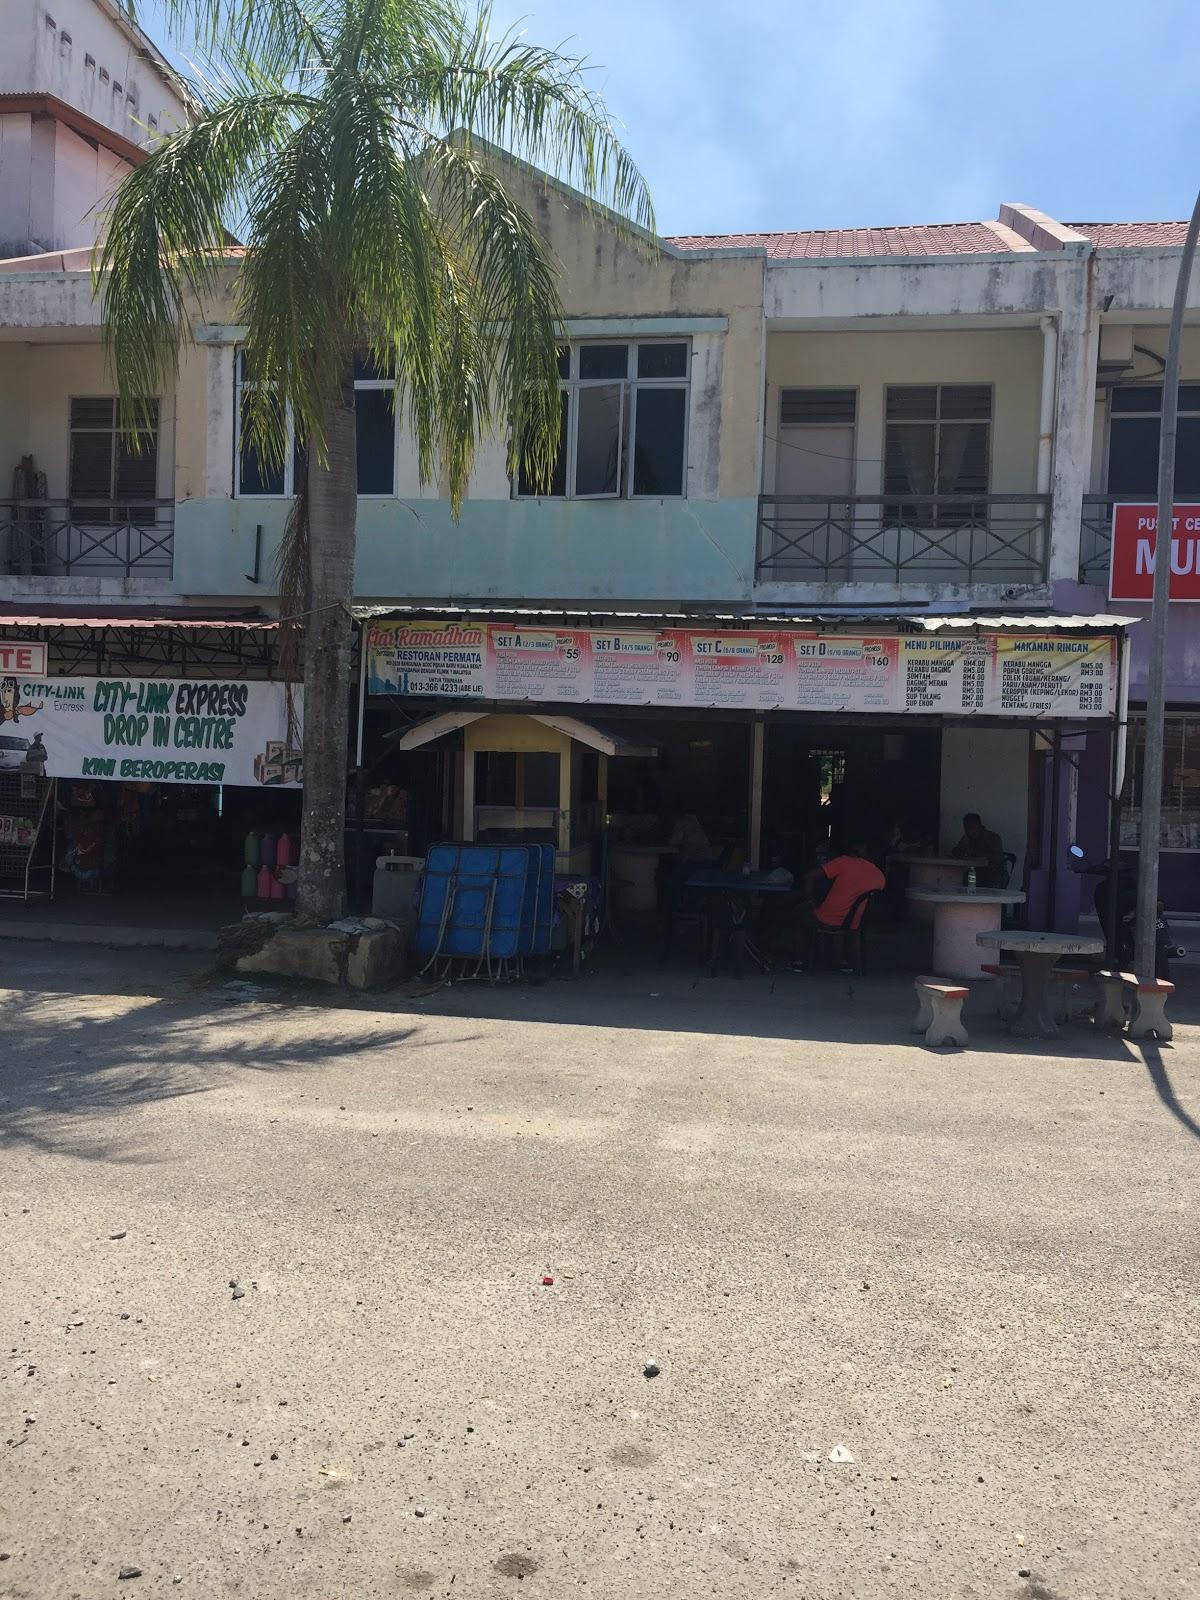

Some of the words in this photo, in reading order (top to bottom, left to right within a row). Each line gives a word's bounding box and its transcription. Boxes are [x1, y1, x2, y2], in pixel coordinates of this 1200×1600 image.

[1138, 517, 1180, 531] PUT
[1135, 538, 1200, 576] MU
[398, 625, 482, 647] Ramadhan
[498, 636, 512, 647] SET
[515, 634, 522, 647] A
[596, 640, 611, 651] SET
[614, 637, 621, 651] B
[697, 643, 713, 653] SET
[715, 640, 722, 653] C
[800, 645, 816, 655] SET
[819, 643, 826, 655] D
[905, 640, 927, 650] MENU
[929, 640, 961, 651] PILIHAN
[1014, 641, 1054, 652] MAKANAN
[1057, 642, 1089, 653] RINGAN
[397, 650, 441, 662] RESTORAN
[443, 652, 482, 664] PERMATA
[566, 649, 580, 659] 55
[666, 652, 680, 662] 90
[767, 654, 784, 664] 128
[871, 656, 889, 666] 160
[1003, 660, 1026, 668] KERABU
[1027, 661, 1052, 669] MANGGA
[1002, 667, 1020, 675] POPIA
[962, 673, 985, 681] RM4.00
[1002, 674, 1021, 682] COLEK
[440, 682, 458, 693] 4233
[906, 679, 928, 687] DAGING
[1002, 681, 1062, 690] PARU/AYAM/PERUT)
[23, 683, 85, 700] CITY-LINK
[1002, 688, 1029, 696] KEROPOK
[1030, 689, 1079, 697] (KEPING/LEKOR)
[1079, 689, 1103, 697] RM3.00
[93, 680, 175, 715] CITY-LINK
[175, 682, 248, 717] EXPRESS
[1001, 695, 1025, 703] NUGGET
[1079, 696, 1103, 704] RM3.00
[54, 700, 84, 712] Express
[1029, 702, 1052, 710] (FRIES)
[1079, 703, 1102, 711] RM3.00
[103, 713, 149, 747] DROP
[152, 715, 171, 748] IN
[174, 716, 237, 749] CENTRE
[81, 757, 117, 777] KINI
[120, 758, 226, 781] BEROPERASI
